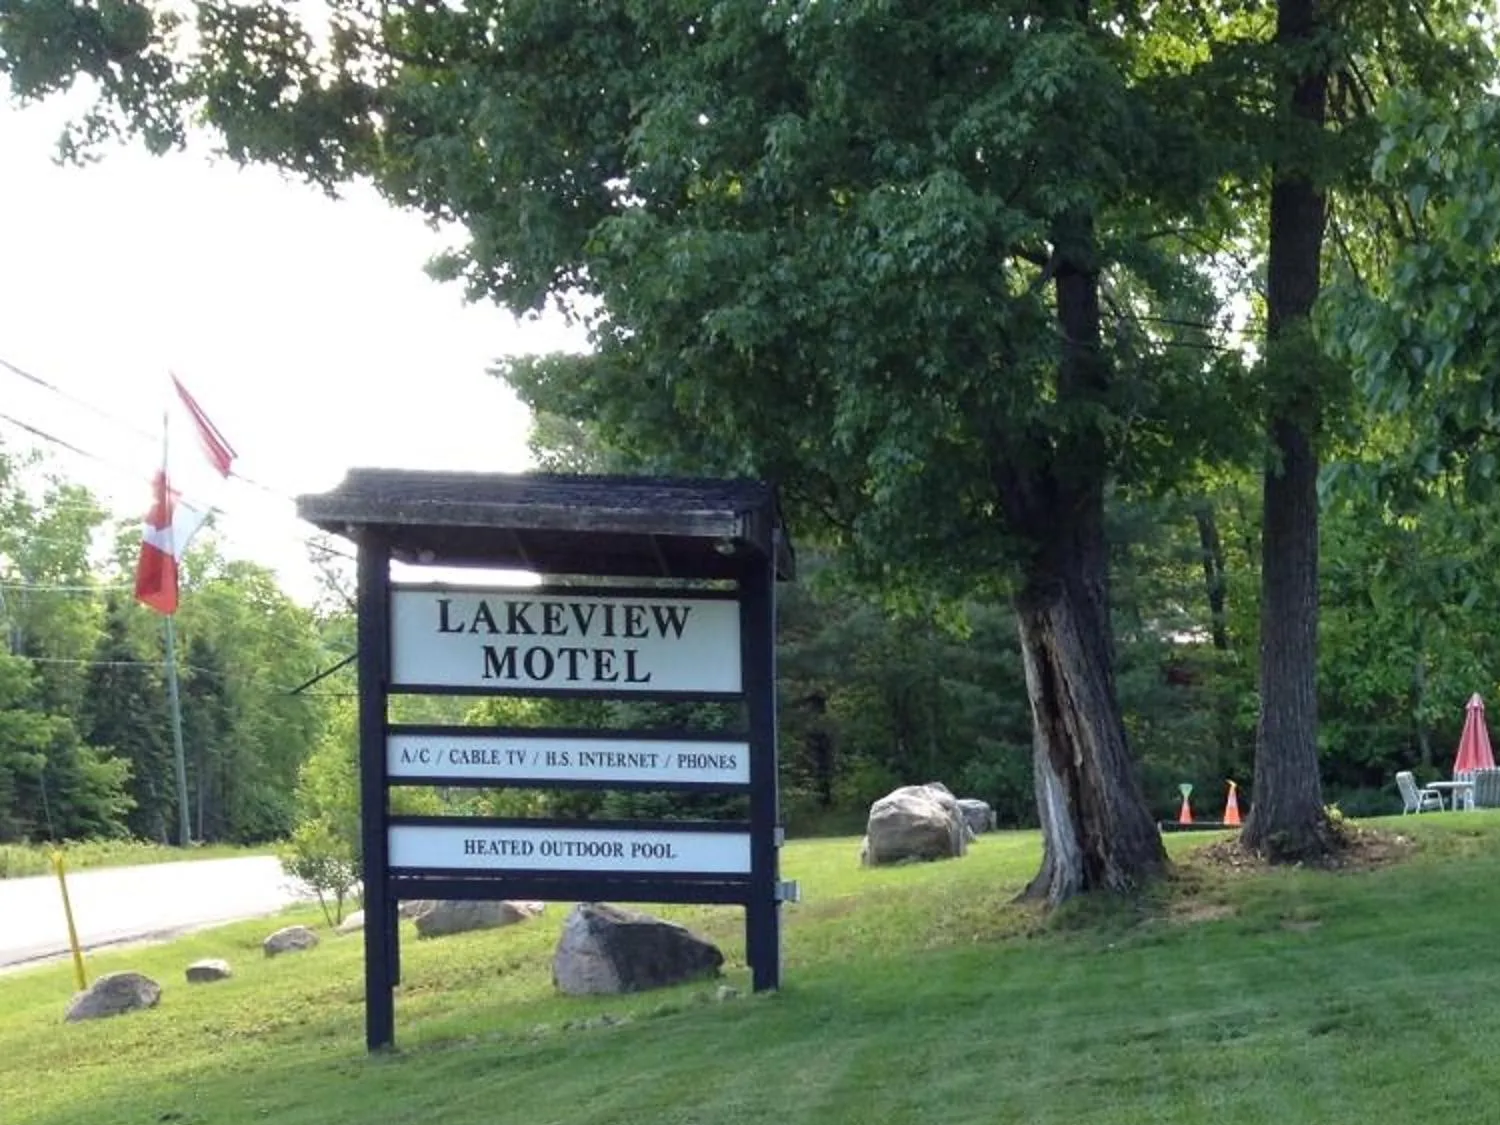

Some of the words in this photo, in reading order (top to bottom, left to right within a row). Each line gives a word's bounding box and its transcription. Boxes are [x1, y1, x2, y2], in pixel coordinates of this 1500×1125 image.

[437, 598, 692, 640] LAKEVIEW
[481, 645, 652, 683] MOTEL
[400, 748, 431, 764] A/C
[449, 749, 500, 765] CABLE
[505, 749, 527, 765] TV
[545, 751, 573, 767] H.S.
[578, 751, 659, 769] INTERNET
[677, 753, 737, 770] PHONES
[463, 839, 534, 856] HEATED
[539, 840, 625, 858] OUTDOOR
[631, 843, 677, 859] POOL
